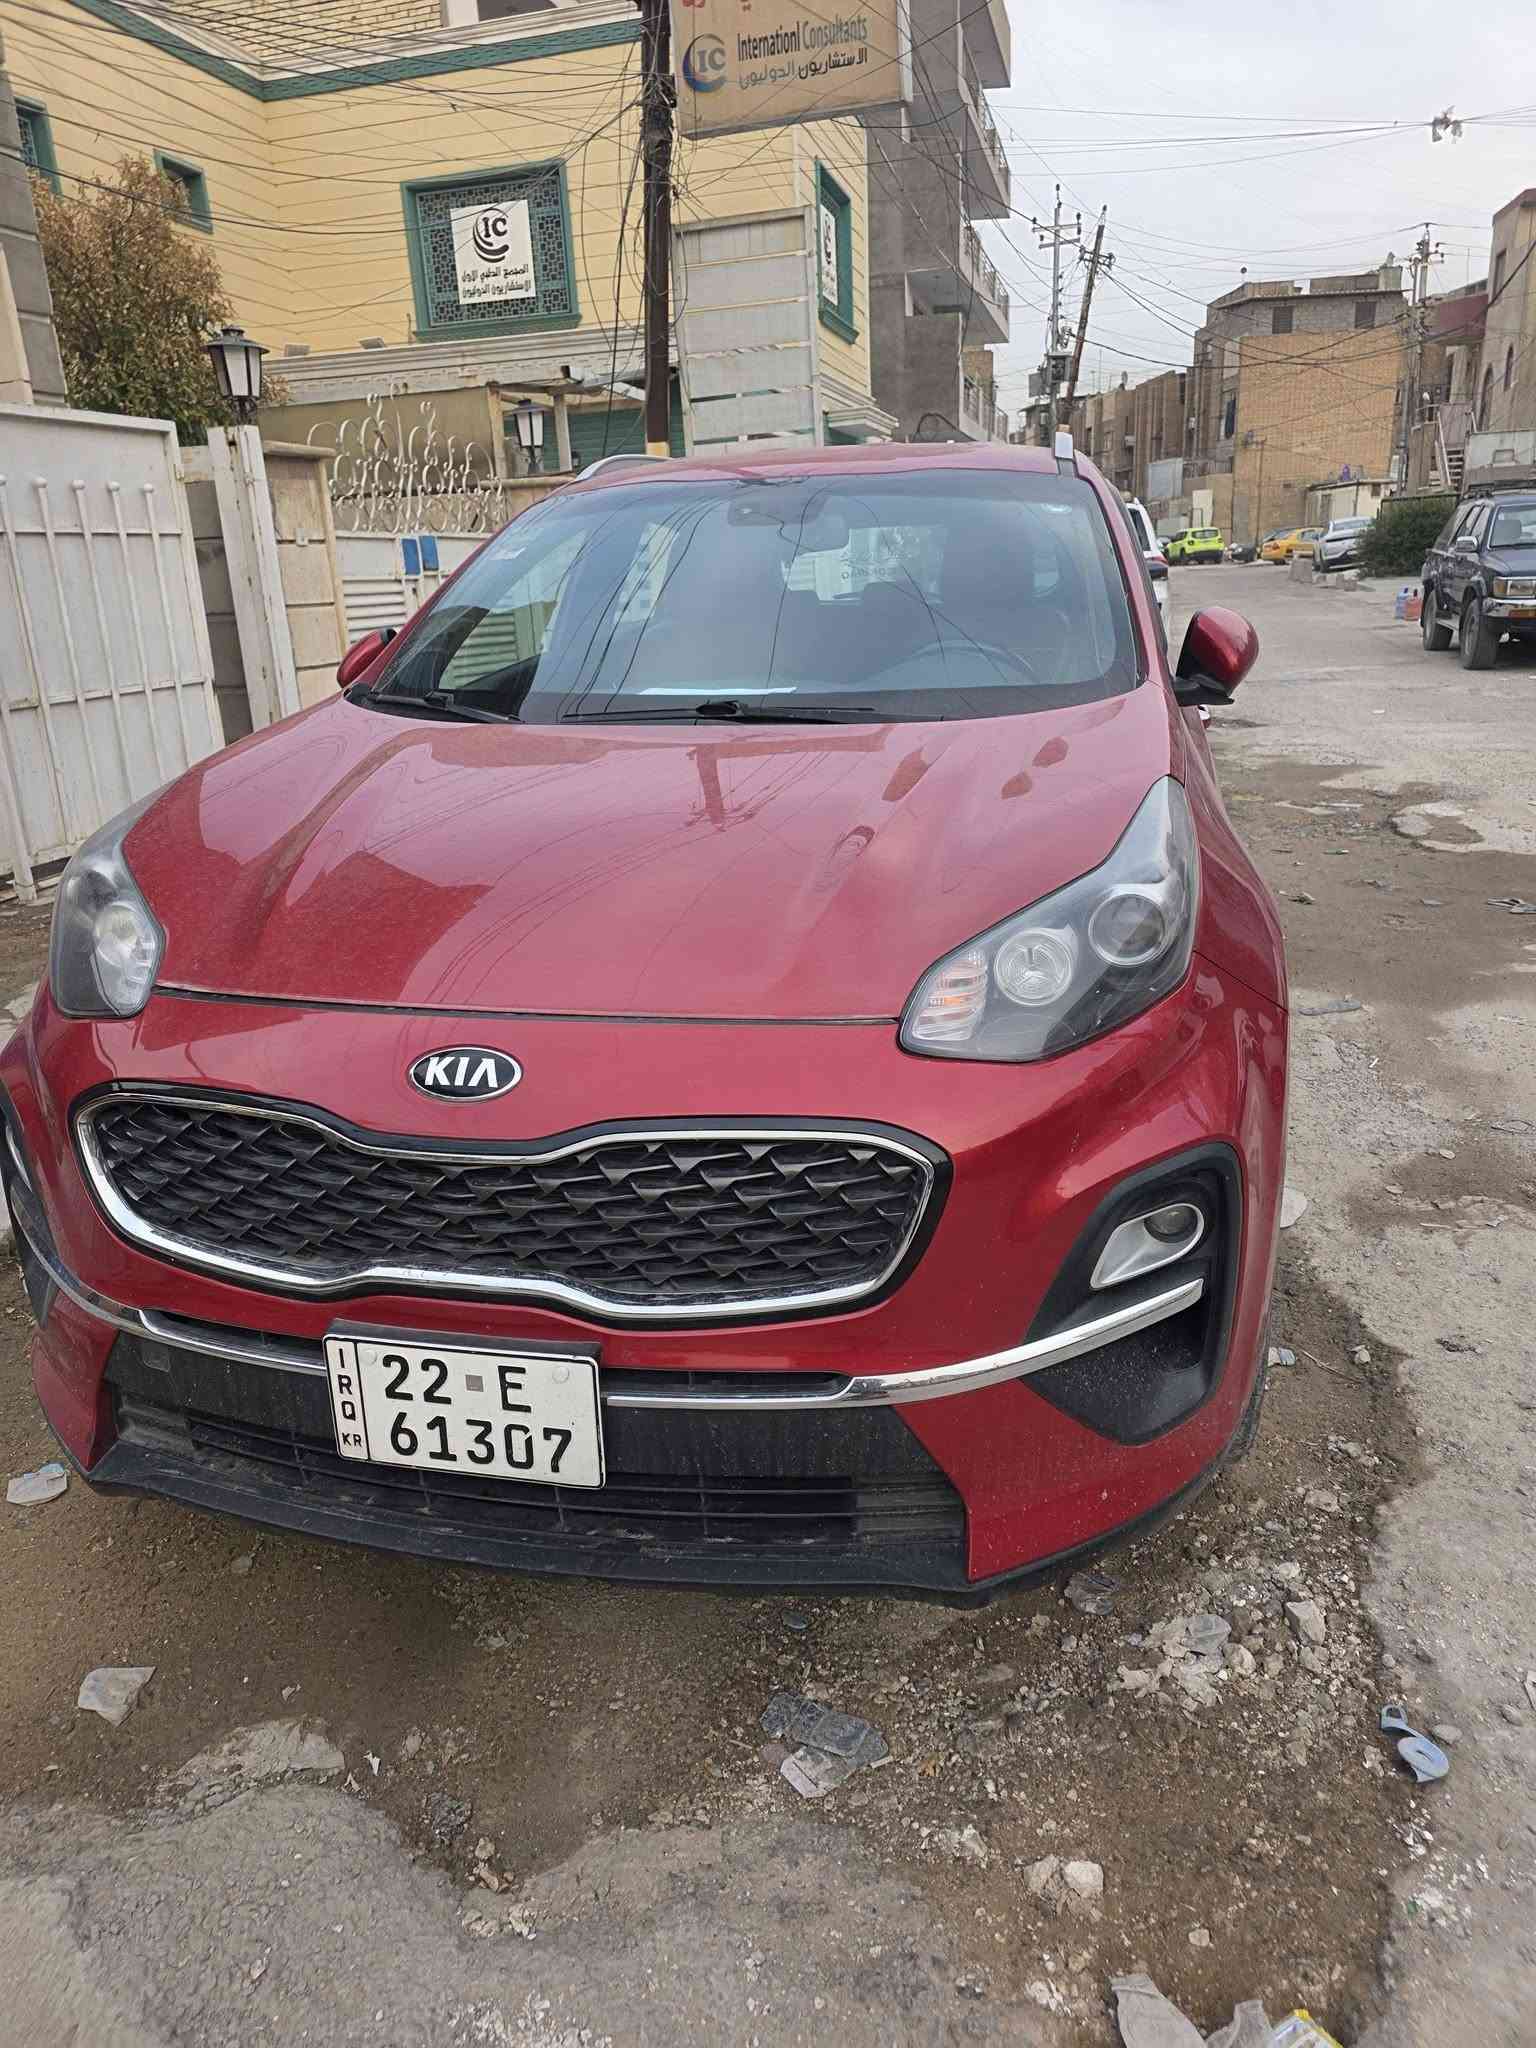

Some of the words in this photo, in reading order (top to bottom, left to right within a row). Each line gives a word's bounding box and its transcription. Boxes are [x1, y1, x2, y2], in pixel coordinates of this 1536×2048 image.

[802, 14, 868, 50] Consultants
[482, 216, 508, 238] IC
[424, 1056, 498, 1088] KIA
[382, 1354, 452, 1405] 22
[497, 1365, 532, 1413] E
[342, 1432, 362, 1448] KR
[390, 1412, 572, 1473] 61307
